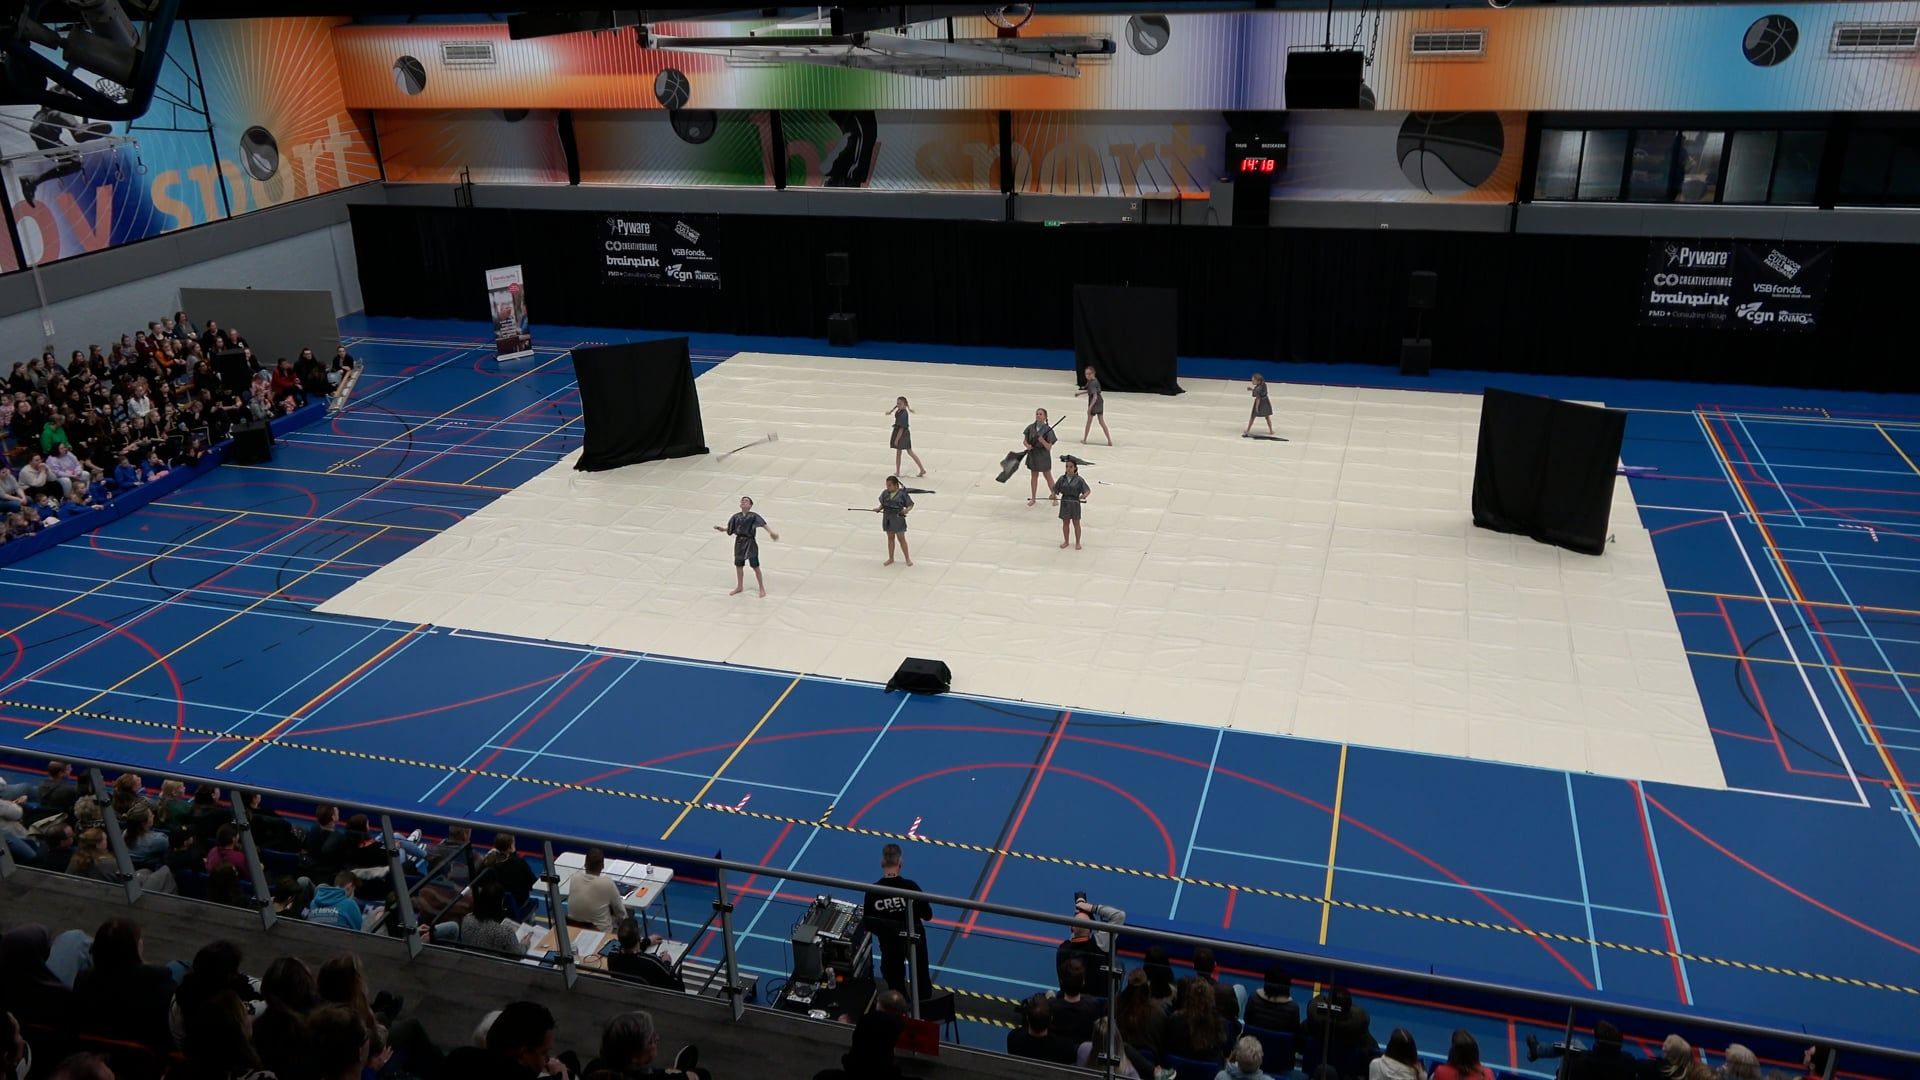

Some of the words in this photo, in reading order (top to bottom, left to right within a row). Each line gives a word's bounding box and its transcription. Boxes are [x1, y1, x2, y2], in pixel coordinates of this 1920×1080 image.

[1242, 159, 1275, 171] 14:18
[617, 219, 651, 235] Pyware
[606, 255, 660, 268] brainpink
[1679, 247, 1728, 267] Pyware
[673, 271, 693, 282] cgn
[1650, 291, 1730, 306] brainpink
[1746, 310, 1774, 324] cgn
